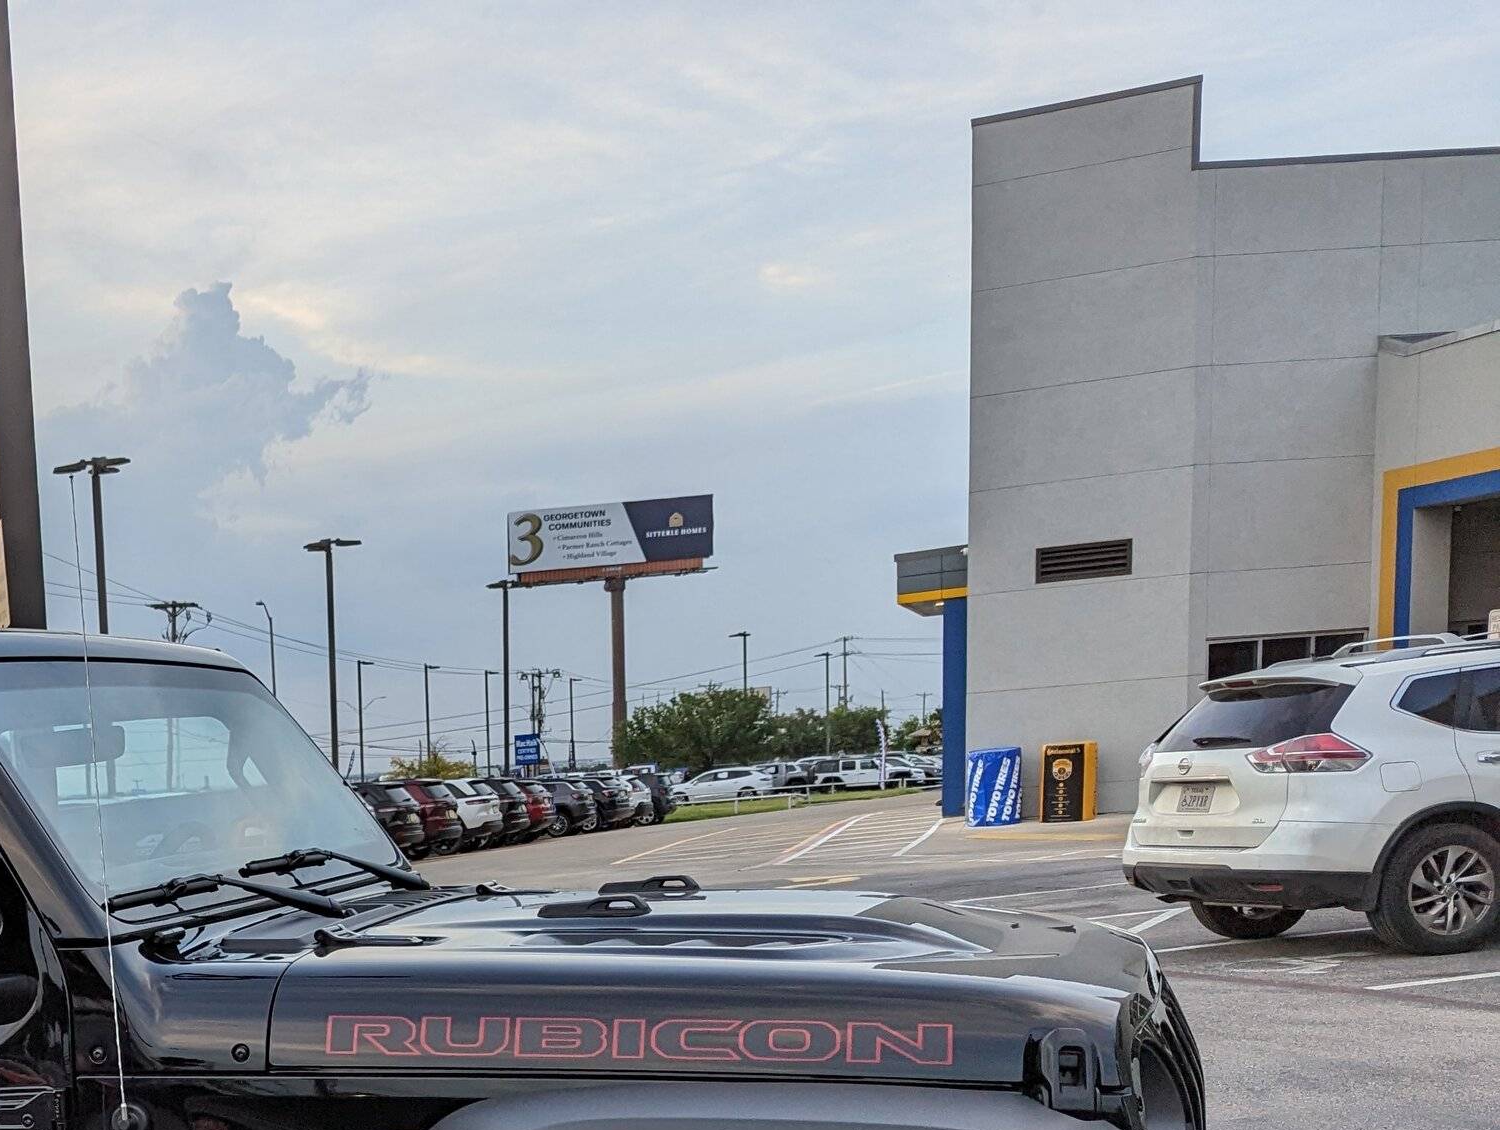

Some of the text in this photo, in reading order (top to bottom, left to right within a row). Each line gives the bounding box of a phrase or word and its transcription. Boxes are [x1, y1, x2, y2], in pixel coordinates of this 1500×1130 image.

[543, 510, 606, 522] GEORGETOWN
[548, 519, 612, 531] COMMUNITIES
[510, 512, 544, 566] 3
[645, 526, 707, 538] SITTERLE HOMES
[566, 550, 617, 560] Highland Village
[985, 757, 1011, 822] TOYO TIRES
[1001, 788, 1016, 821] TOYO
[325, 1014, 954, 1066] RUBICON
